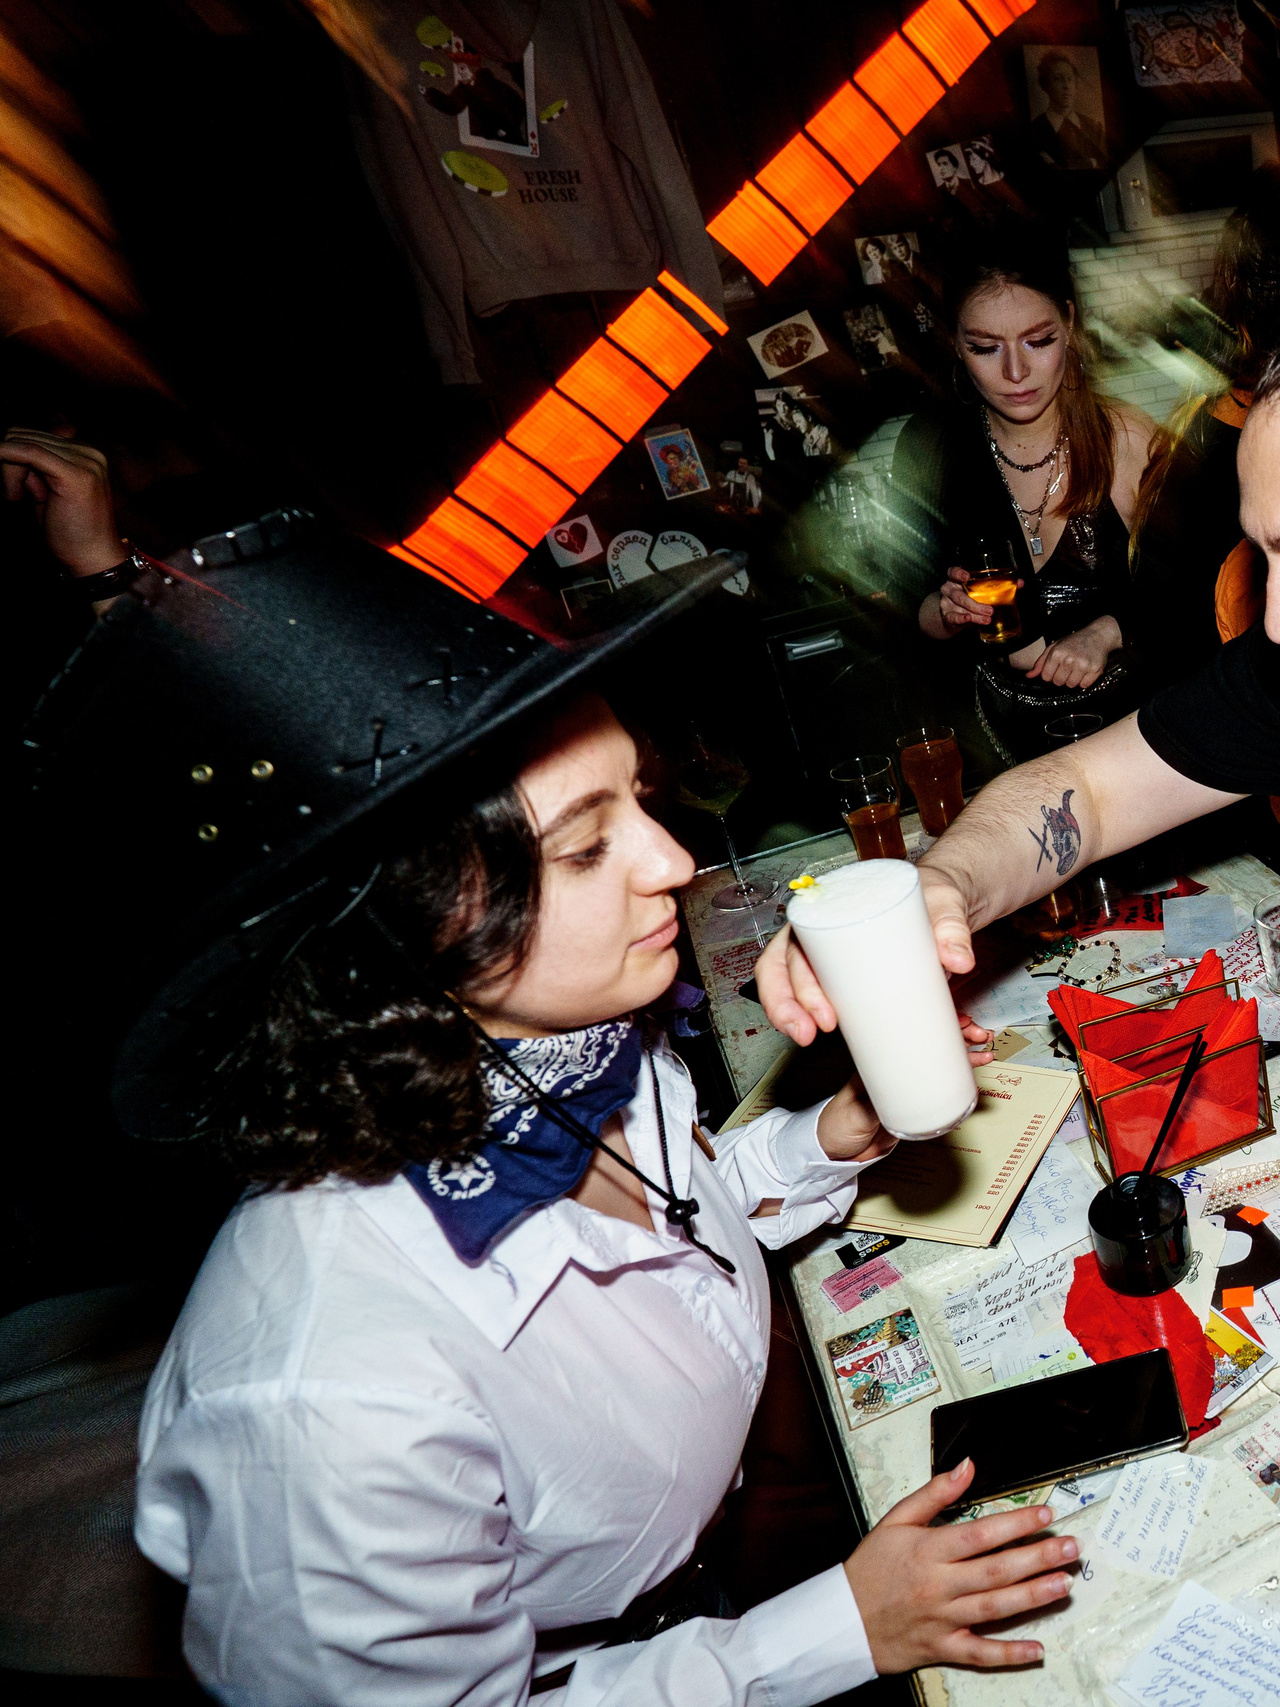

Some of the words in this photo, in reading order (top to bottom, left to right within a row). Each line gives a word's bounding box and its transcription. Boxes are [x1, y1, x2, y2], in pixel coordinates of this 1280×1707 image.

[524, 169, 581, 186] FRESH
[517, 187, 579, 204] HOUSE
[610, 534, 648, 561] сердец
[976, 1086, 1013, 1101] астойки
[953, 1332, 980, 1348] SEAT
[997, 1315, 1018, 1329] 47E
